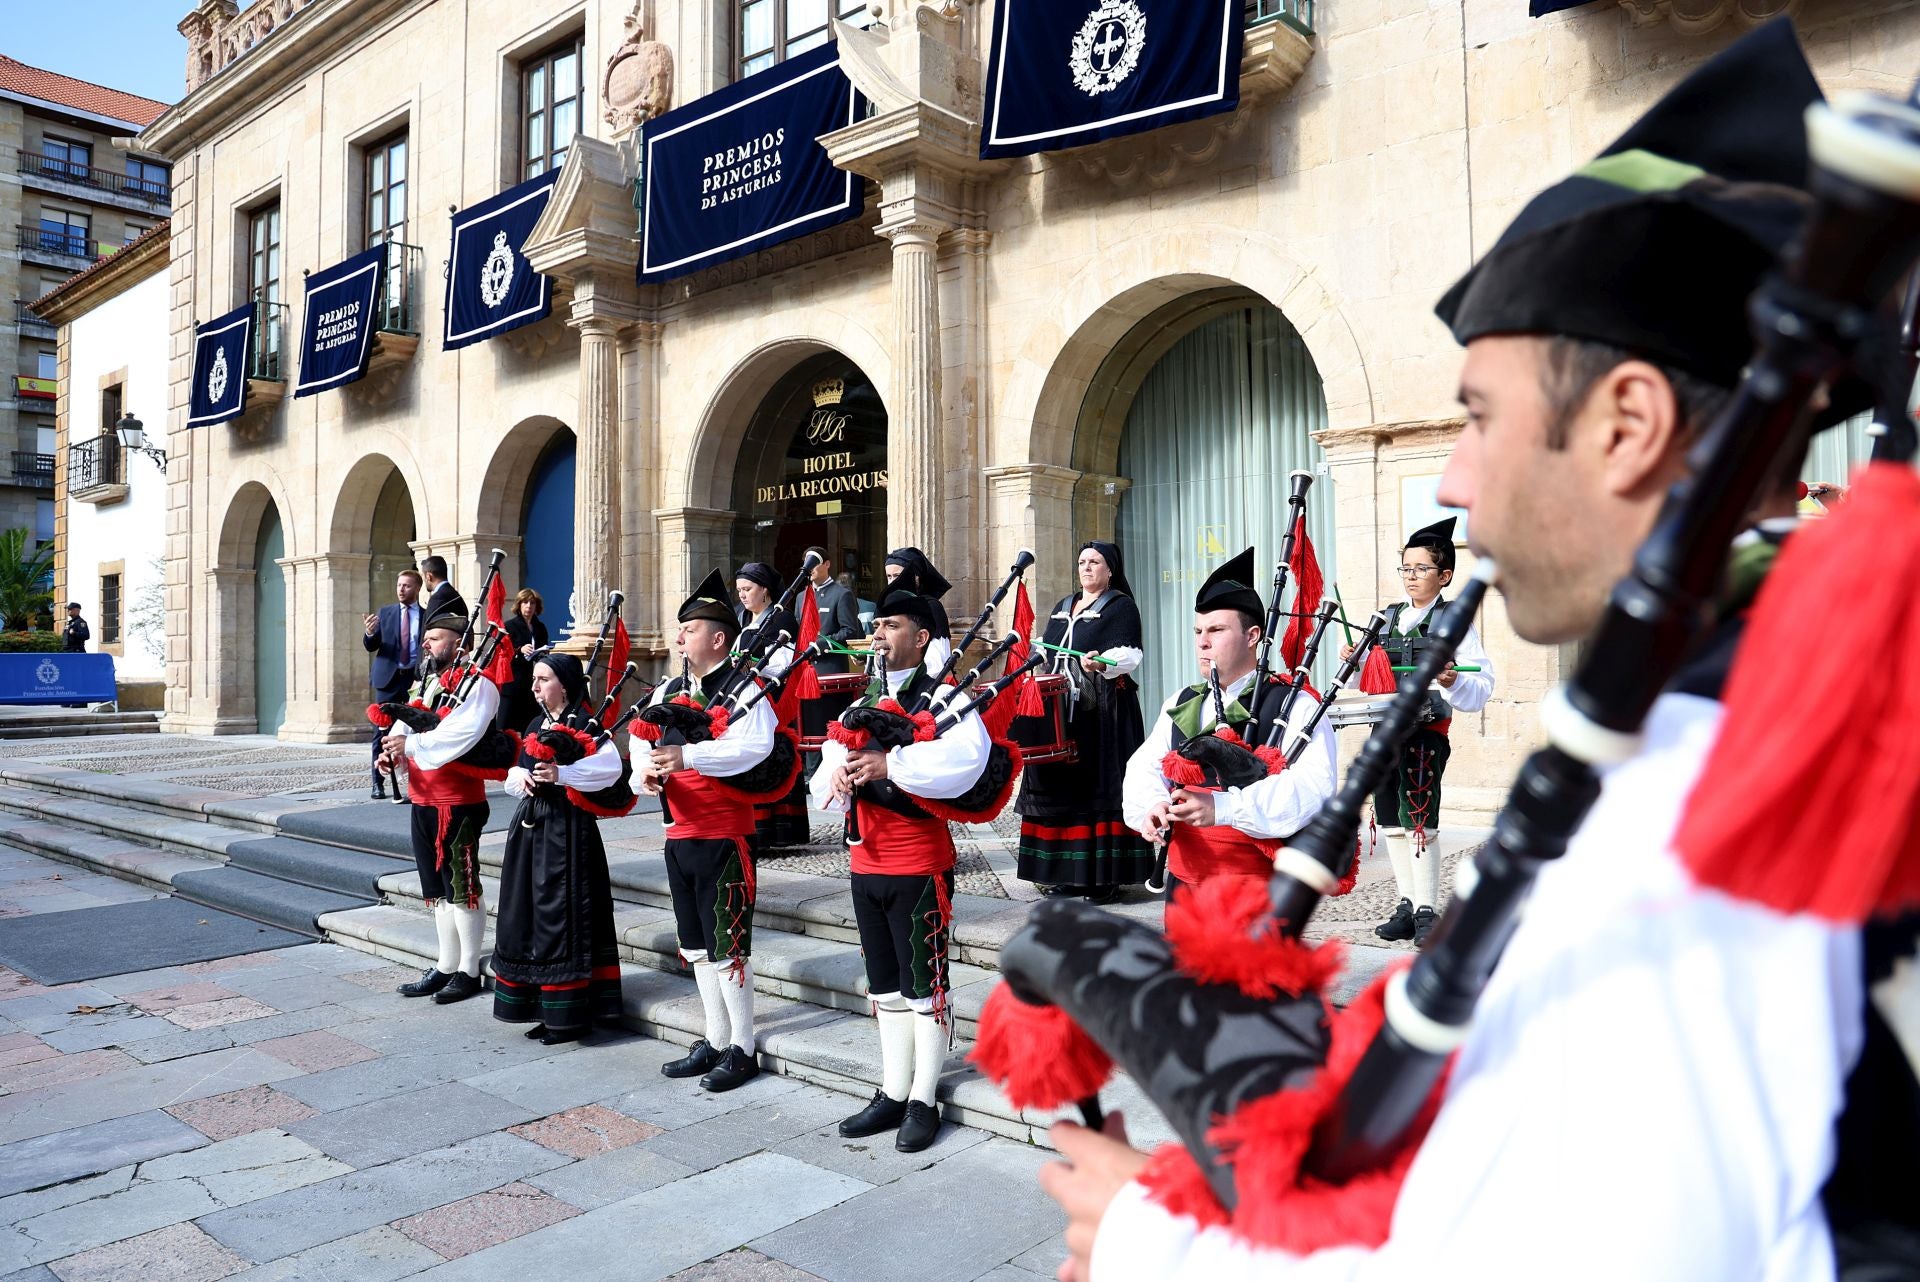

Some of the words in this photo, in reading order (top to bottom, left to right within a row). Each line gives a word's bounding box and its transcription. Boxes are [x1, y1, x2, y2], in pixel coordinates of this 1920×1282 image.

[703, 128, 784, 174] PREMIOS
[702, 150, 782, 194] PRINCESA
[701, 195, 717, 210] DE
[721, 170, 781, 204] ASTURIAS
[318, 301, 359, 327] PREMIOS
[316, 316, 358, 341] PRINCESA
[315, 342, 324, 352] DE
[325, 331, 357, 349] ASTURIAS
[803, 451, 855, 474] HOTEL
[757, 486, 776, 503] DE
[778, 483, 797, 500] LA
